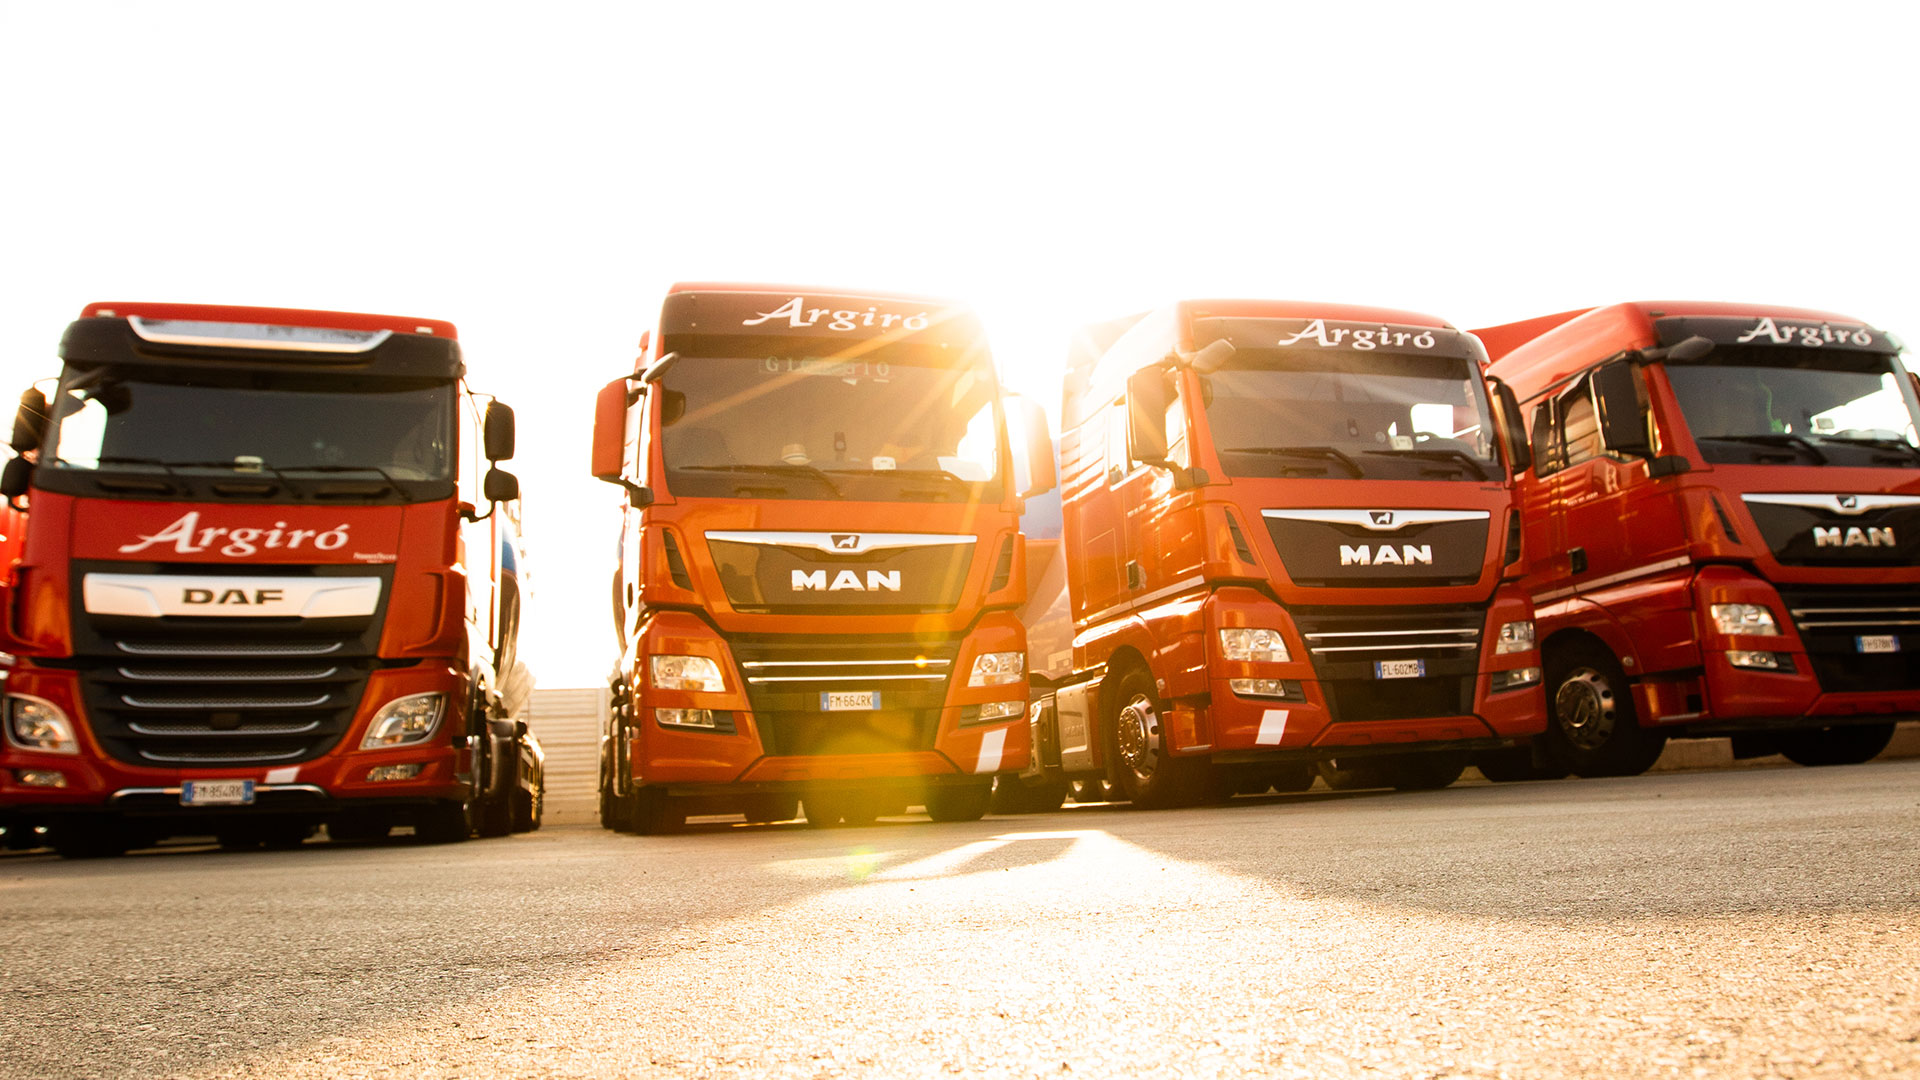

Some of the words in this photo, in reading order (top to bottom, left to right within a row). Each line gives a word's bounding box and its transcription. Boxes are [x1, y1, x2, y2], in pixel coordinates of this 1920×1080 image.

[742, 297, 929, 331] Argiró
[1278, 319, 1435, 350] Argiró
[1736, 317, 1872, 347] Argiró
[765, 356, 890, 377] GIGIO
[119, 511, 350, 557] Argiró
[1813, 527, 1896, 547] MAN
[1340, 545, 1433, 565] MAN
[792, 570, 901, 591] MAN
[182, 589, 284, 605] DAF
